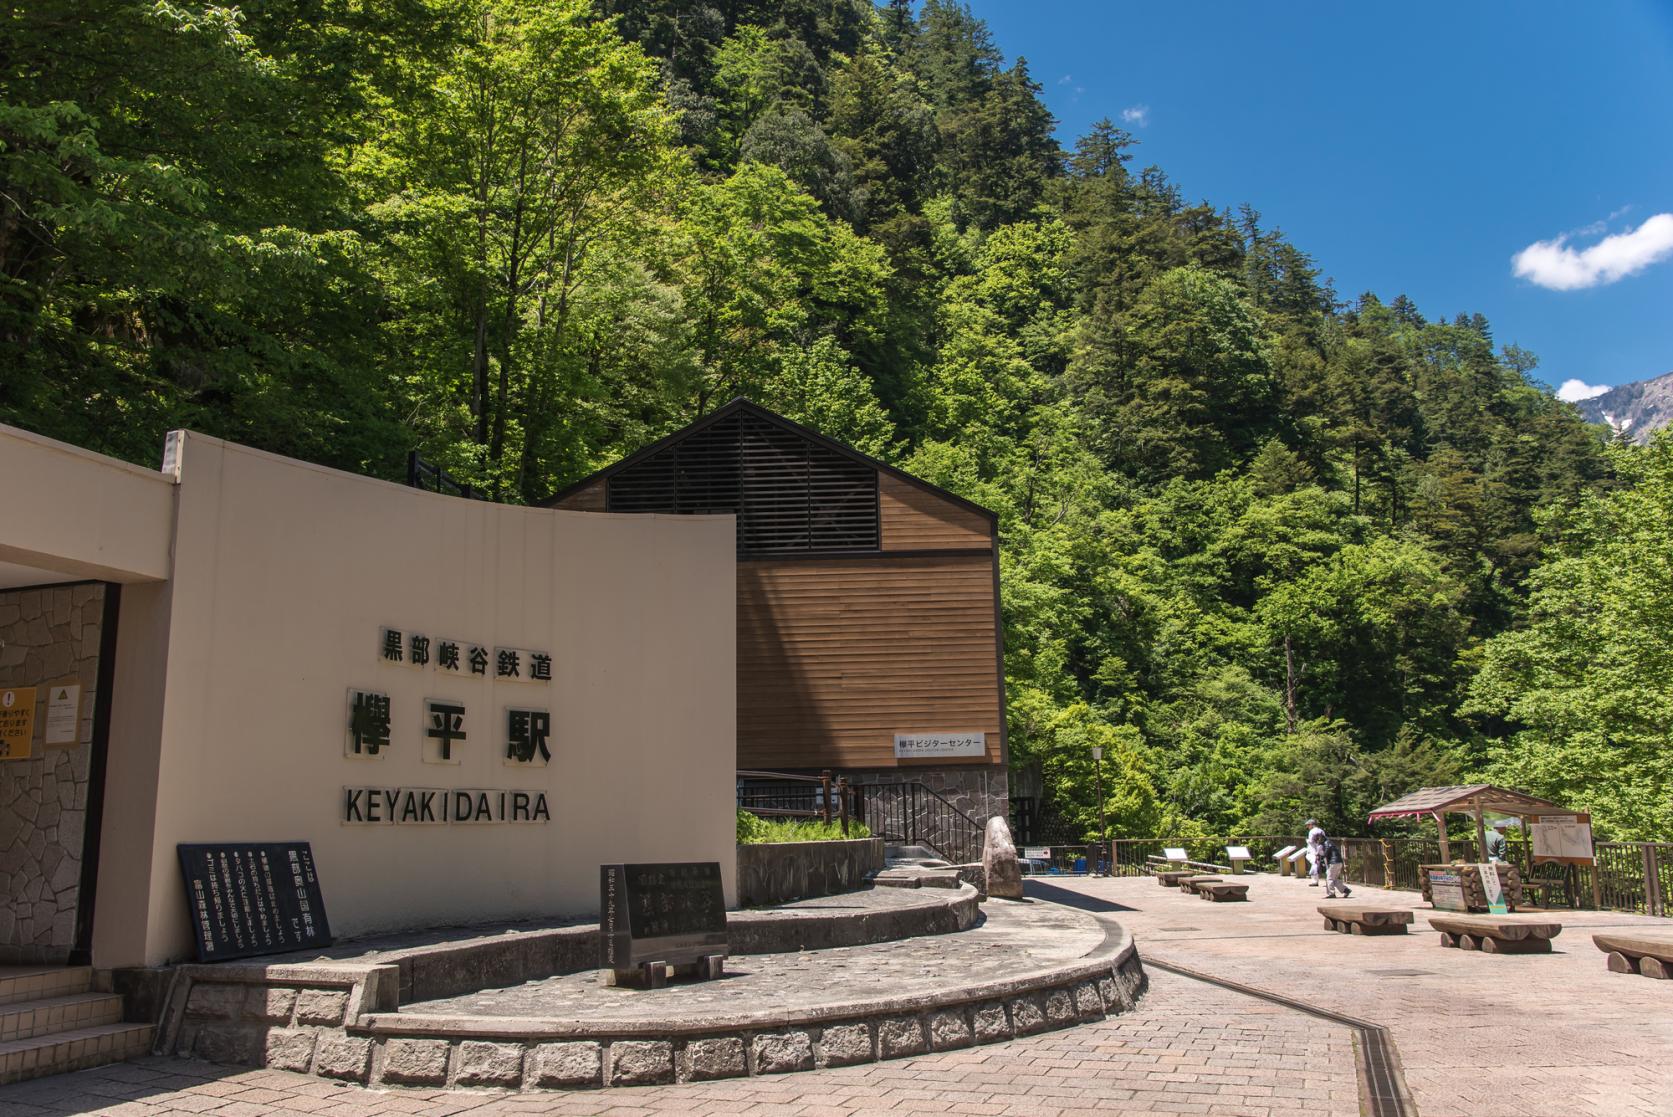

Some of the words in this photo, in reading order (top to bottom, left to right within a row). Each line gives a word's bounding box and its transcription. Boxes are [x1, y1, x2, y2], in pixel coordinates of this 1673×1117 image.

[384, 629, 552, 681] 黒部峡谷鉄道
[352, 692, 552, 762] 欅平駅
[346, 789, 551, 822] KEYAKIDAIRA
[288, 850, 315, 937] 黒部奥山国有林
[291, 917, 302, 943] です
